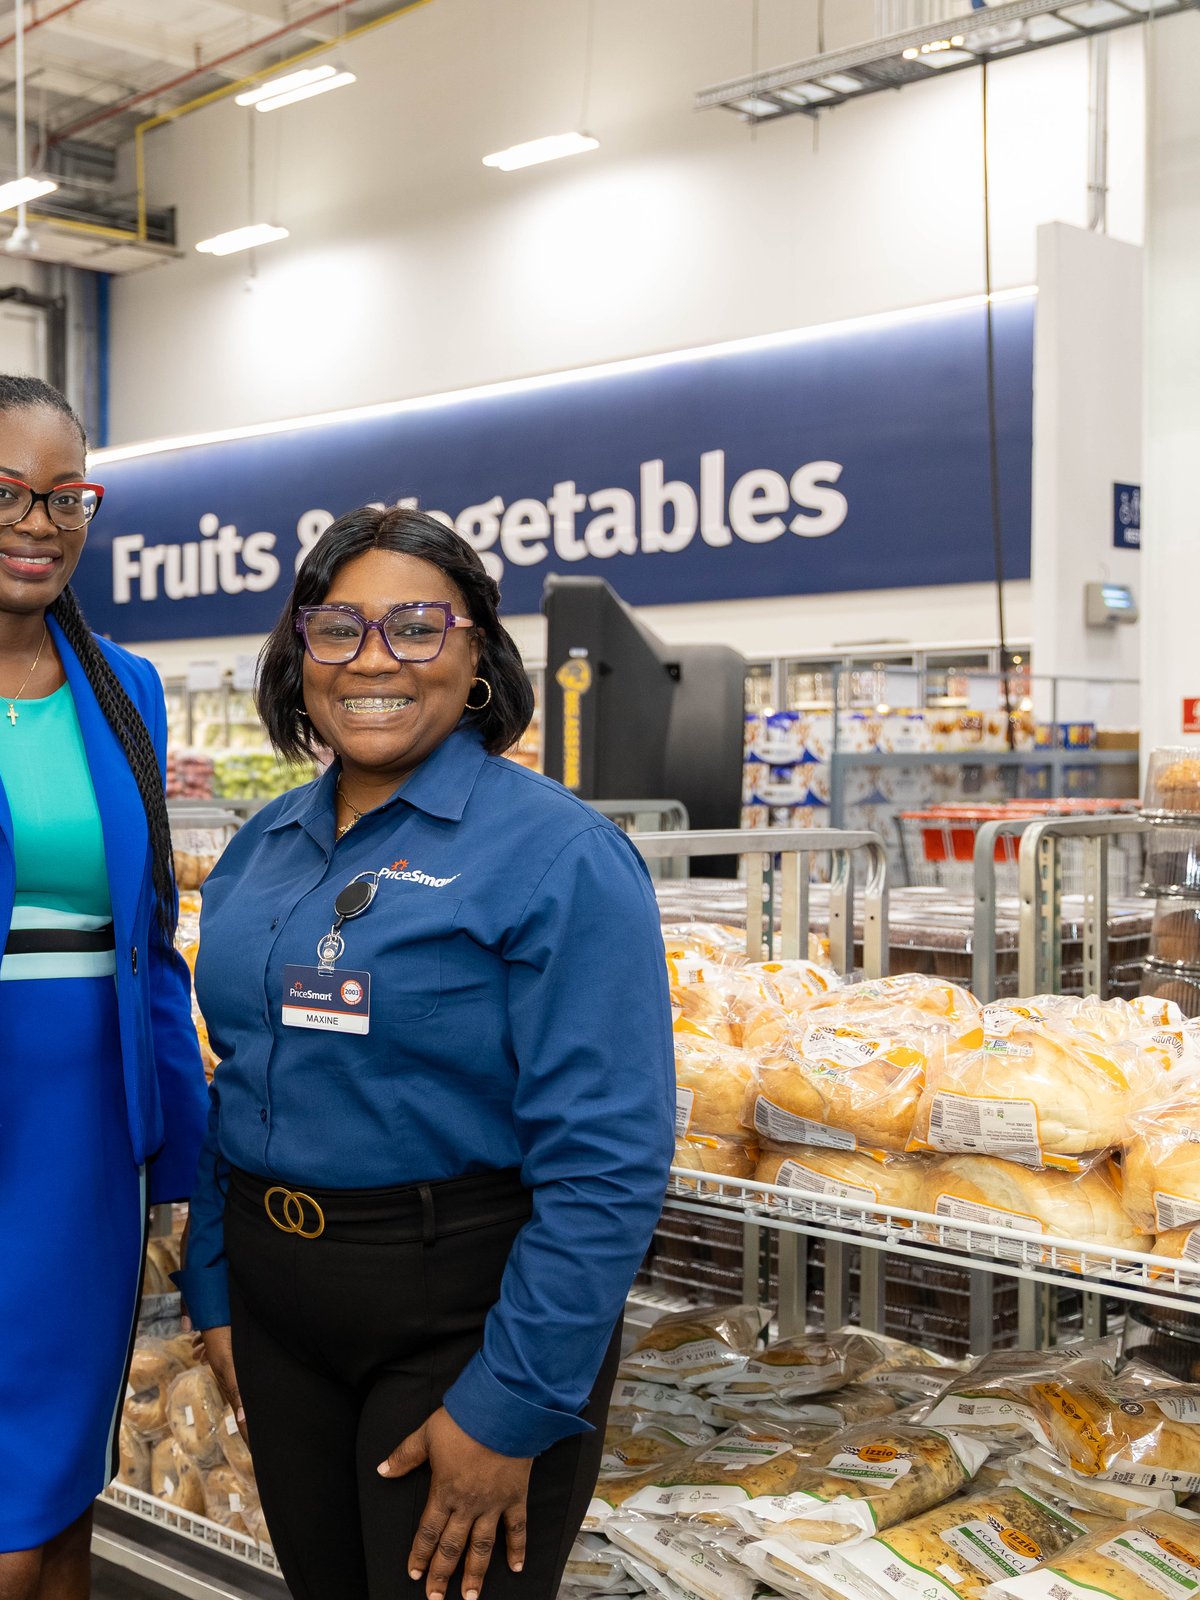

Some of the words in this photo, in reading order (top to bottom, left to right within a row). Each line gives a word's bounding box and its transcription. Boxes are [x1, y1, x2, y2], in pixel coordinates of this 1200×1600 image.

[112, 513, 280, 605] Fruits
[364, 449, 848, 583] getables
[378, 867, 461, 888] PriceSmar
[289, 987, 332, 1001] PriceSmart
[306, 1014, 339, 1026] MAXINE
[865, 1447, 894, 1457] izzio
[838, 1462, 898, 1473] FOCACCIA
[1007, 1531, 1037, 1554] izzio
[1132, 1537, 1199, 1581] FACCIA
